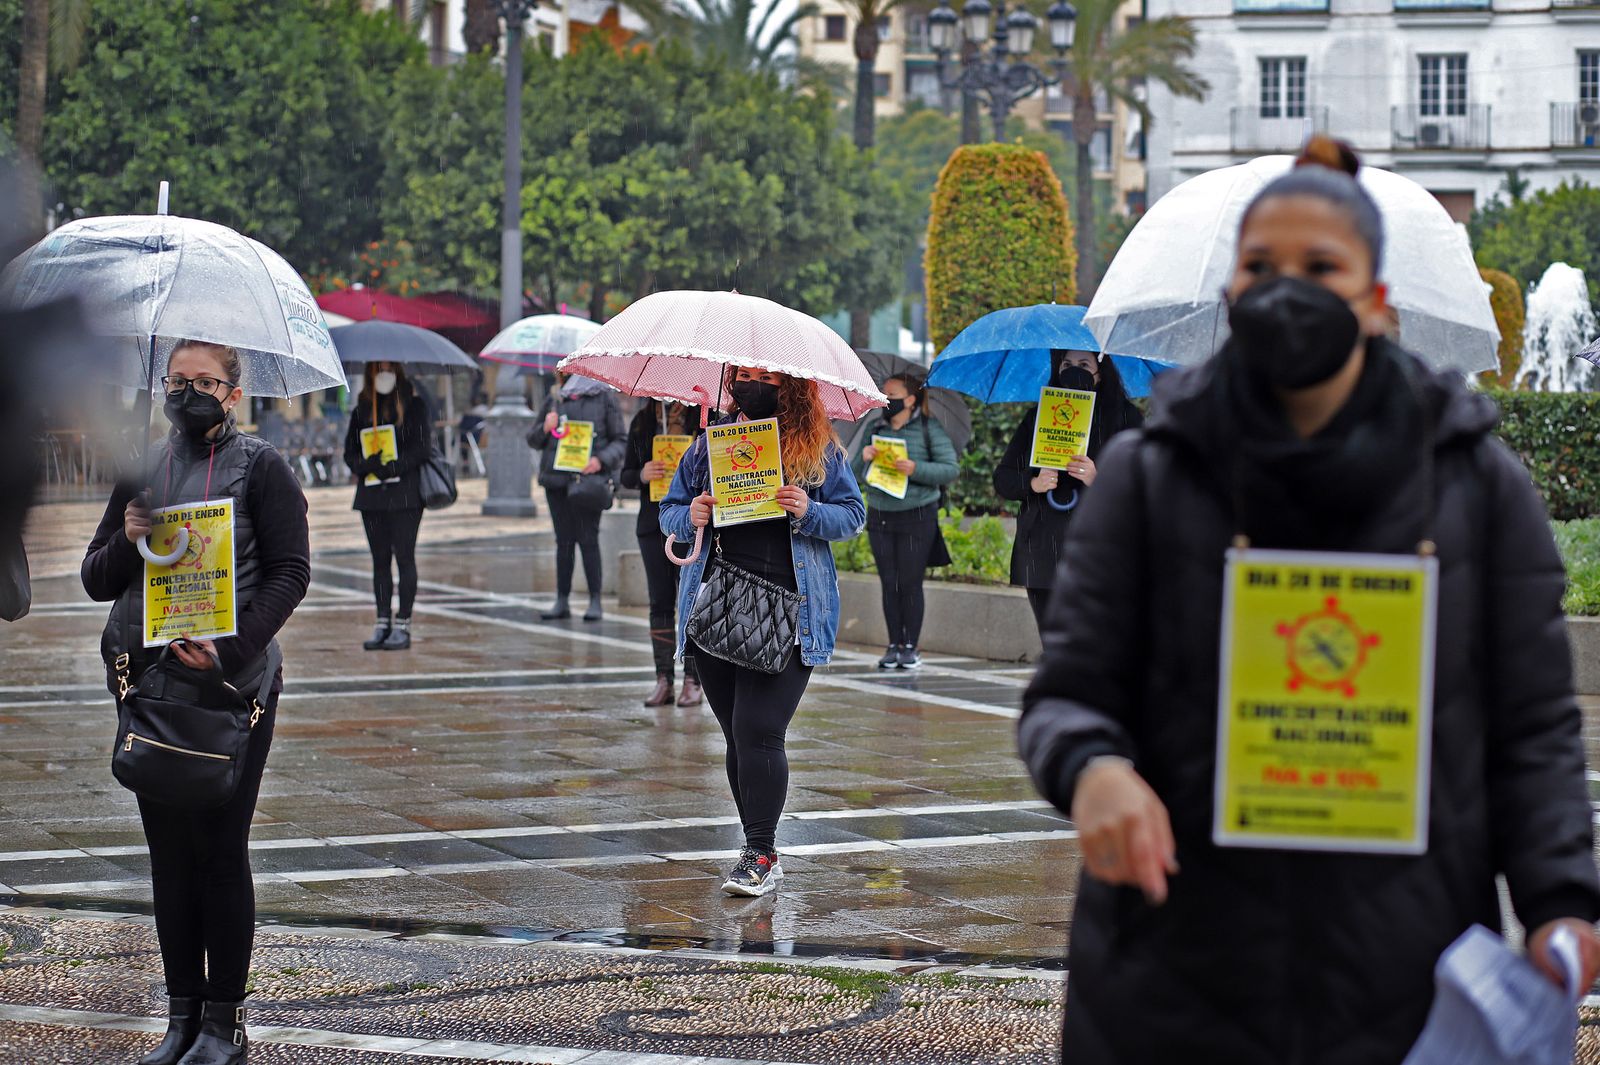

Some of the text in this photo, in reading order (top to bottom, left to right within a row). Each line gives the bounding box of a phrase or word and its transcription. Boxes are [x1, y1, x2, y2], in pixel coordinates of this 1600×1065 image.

[712, 430, 725, 438] DIA
[738, 426, 747, 434] DE
[749, 424, 772, 433] ENERO
[1038, 427, 1086, 438] CONCENTRACIÓN
[1046, 434, 1075, 443] NACIONAL
[716, 468, 778, 484] CONCENTRACIÓN
[728, 478, 766, 490] NACIONAL
[753, 492, 768, 500] 10%
[167, 513, 178, 524] 20
[181, 511, 193, 522] DE
[195, 508, 225, 520] ENERO
[150, 568, 228, 587] CONCENTRACIÓN
[166, 582, 213, 595] NACIONAL
[163, 605, 180, 615] IVA
[184, 603, 192, 613] al
[196, 601, 216, 612] 10%
